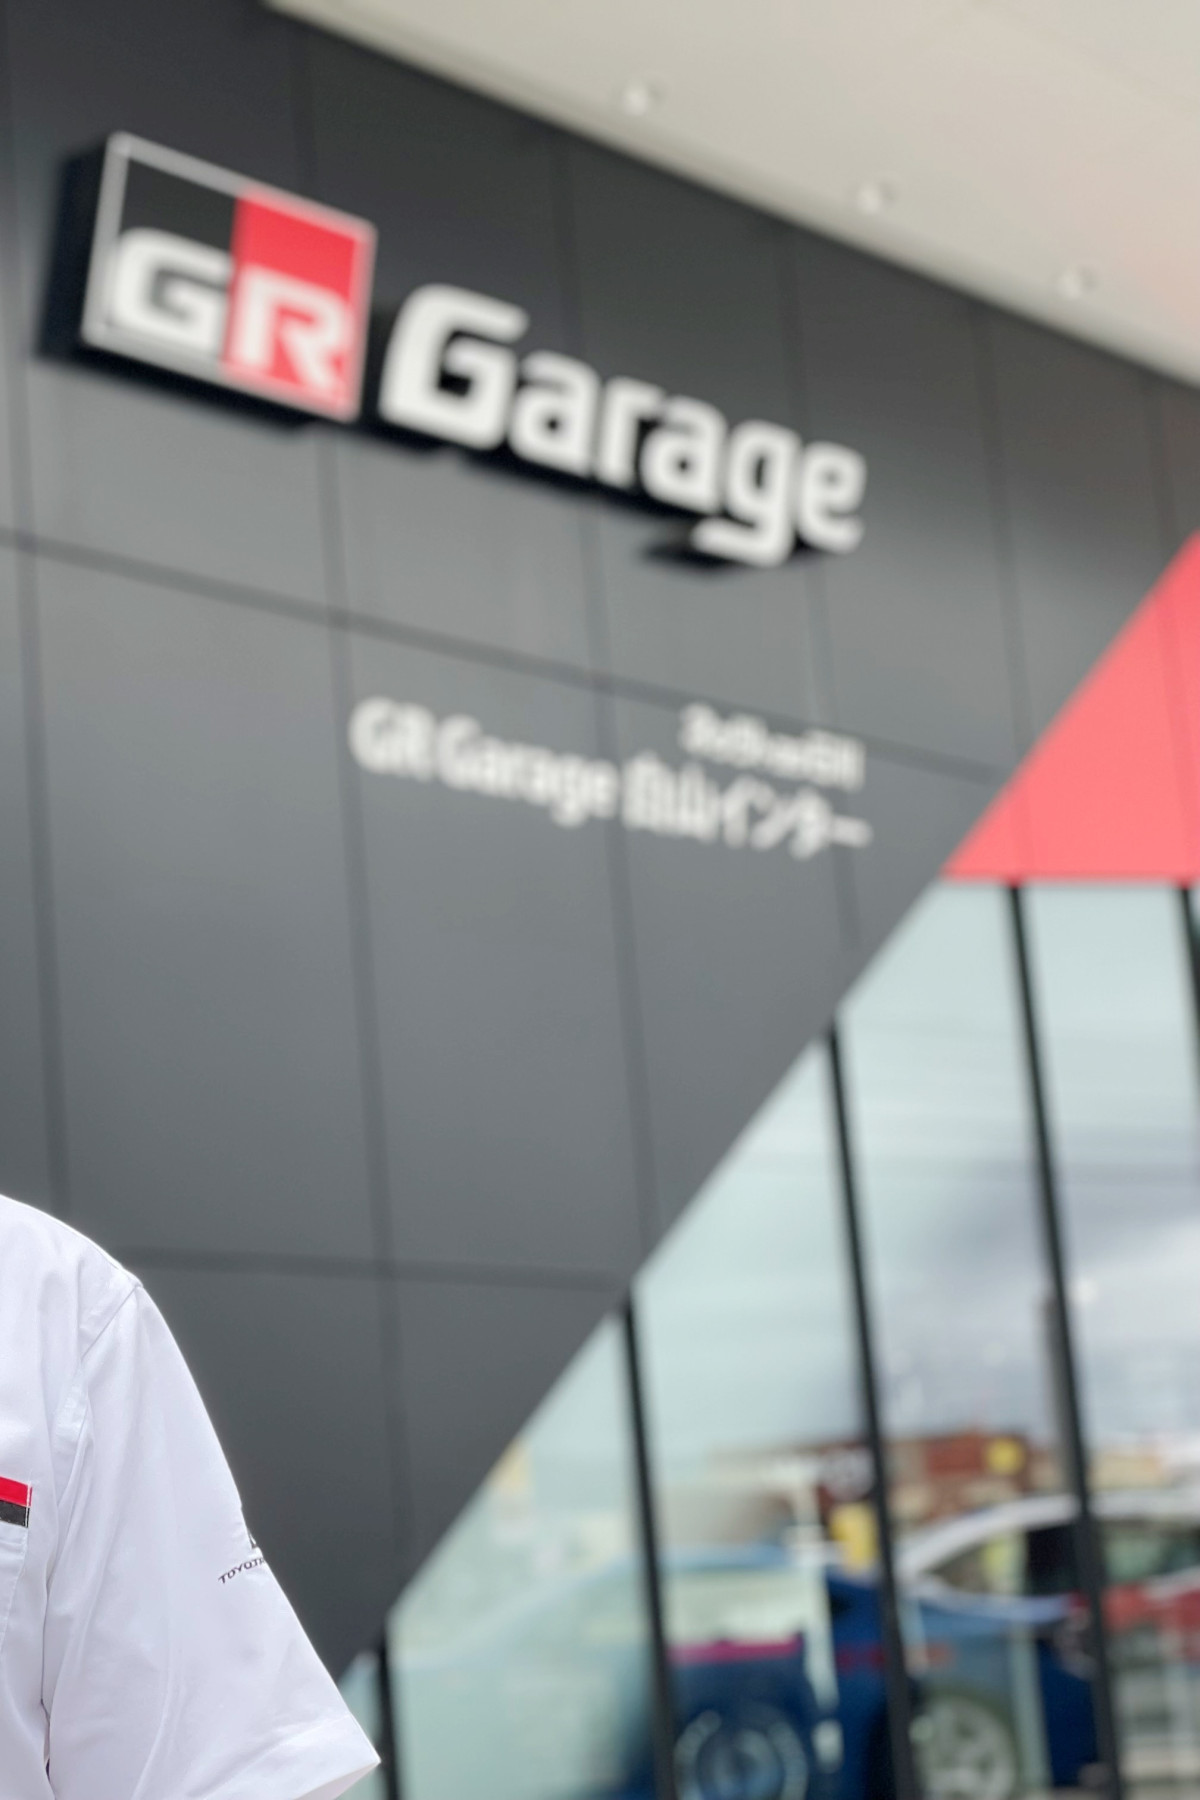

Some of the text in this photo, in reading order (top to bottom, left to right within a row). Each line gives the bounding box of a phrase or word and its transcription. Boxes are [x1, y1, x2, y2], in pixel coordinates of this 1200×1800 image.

[108, 226, 866, 567] GR Garage
[349, 697, 436, 781] GR
[437, 714, 620, 828] Garage
